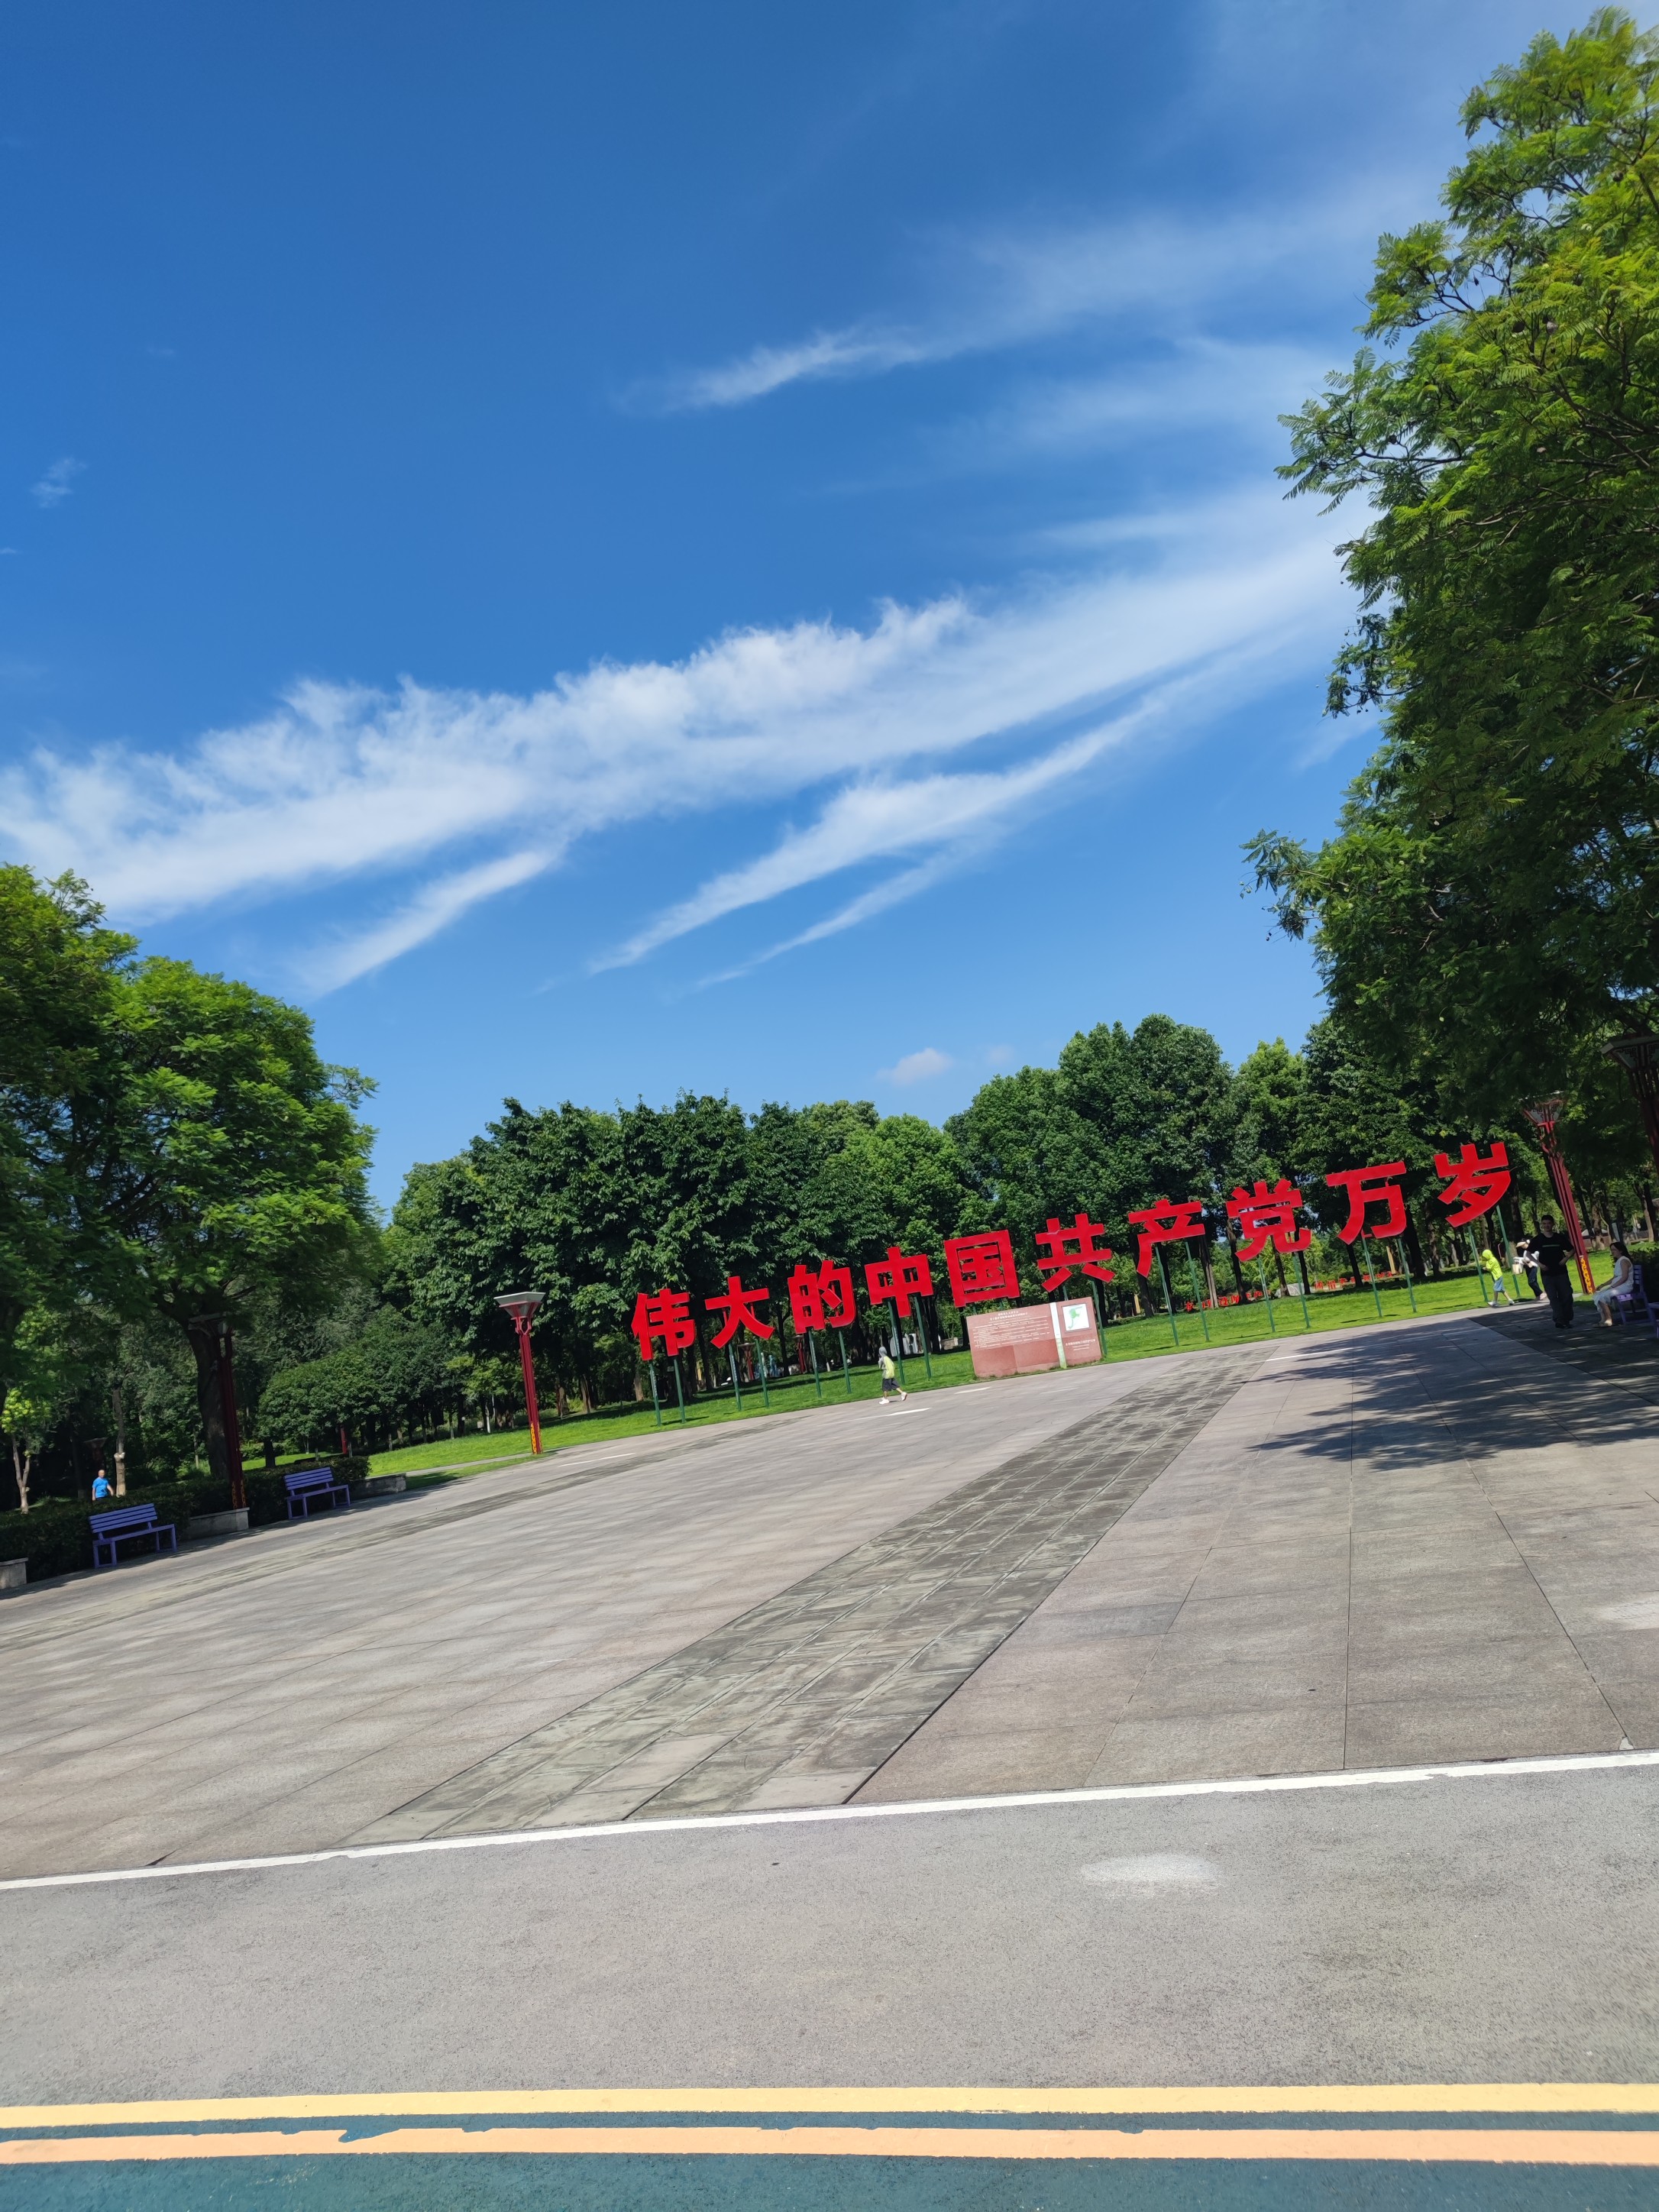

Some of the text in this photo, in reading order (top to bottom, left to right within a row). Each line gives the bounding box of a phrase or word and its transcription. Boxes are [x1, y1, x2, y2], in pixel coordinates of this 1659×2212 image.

[631, 1143, 1512, 1361] 伟大的中国共产党万岁
